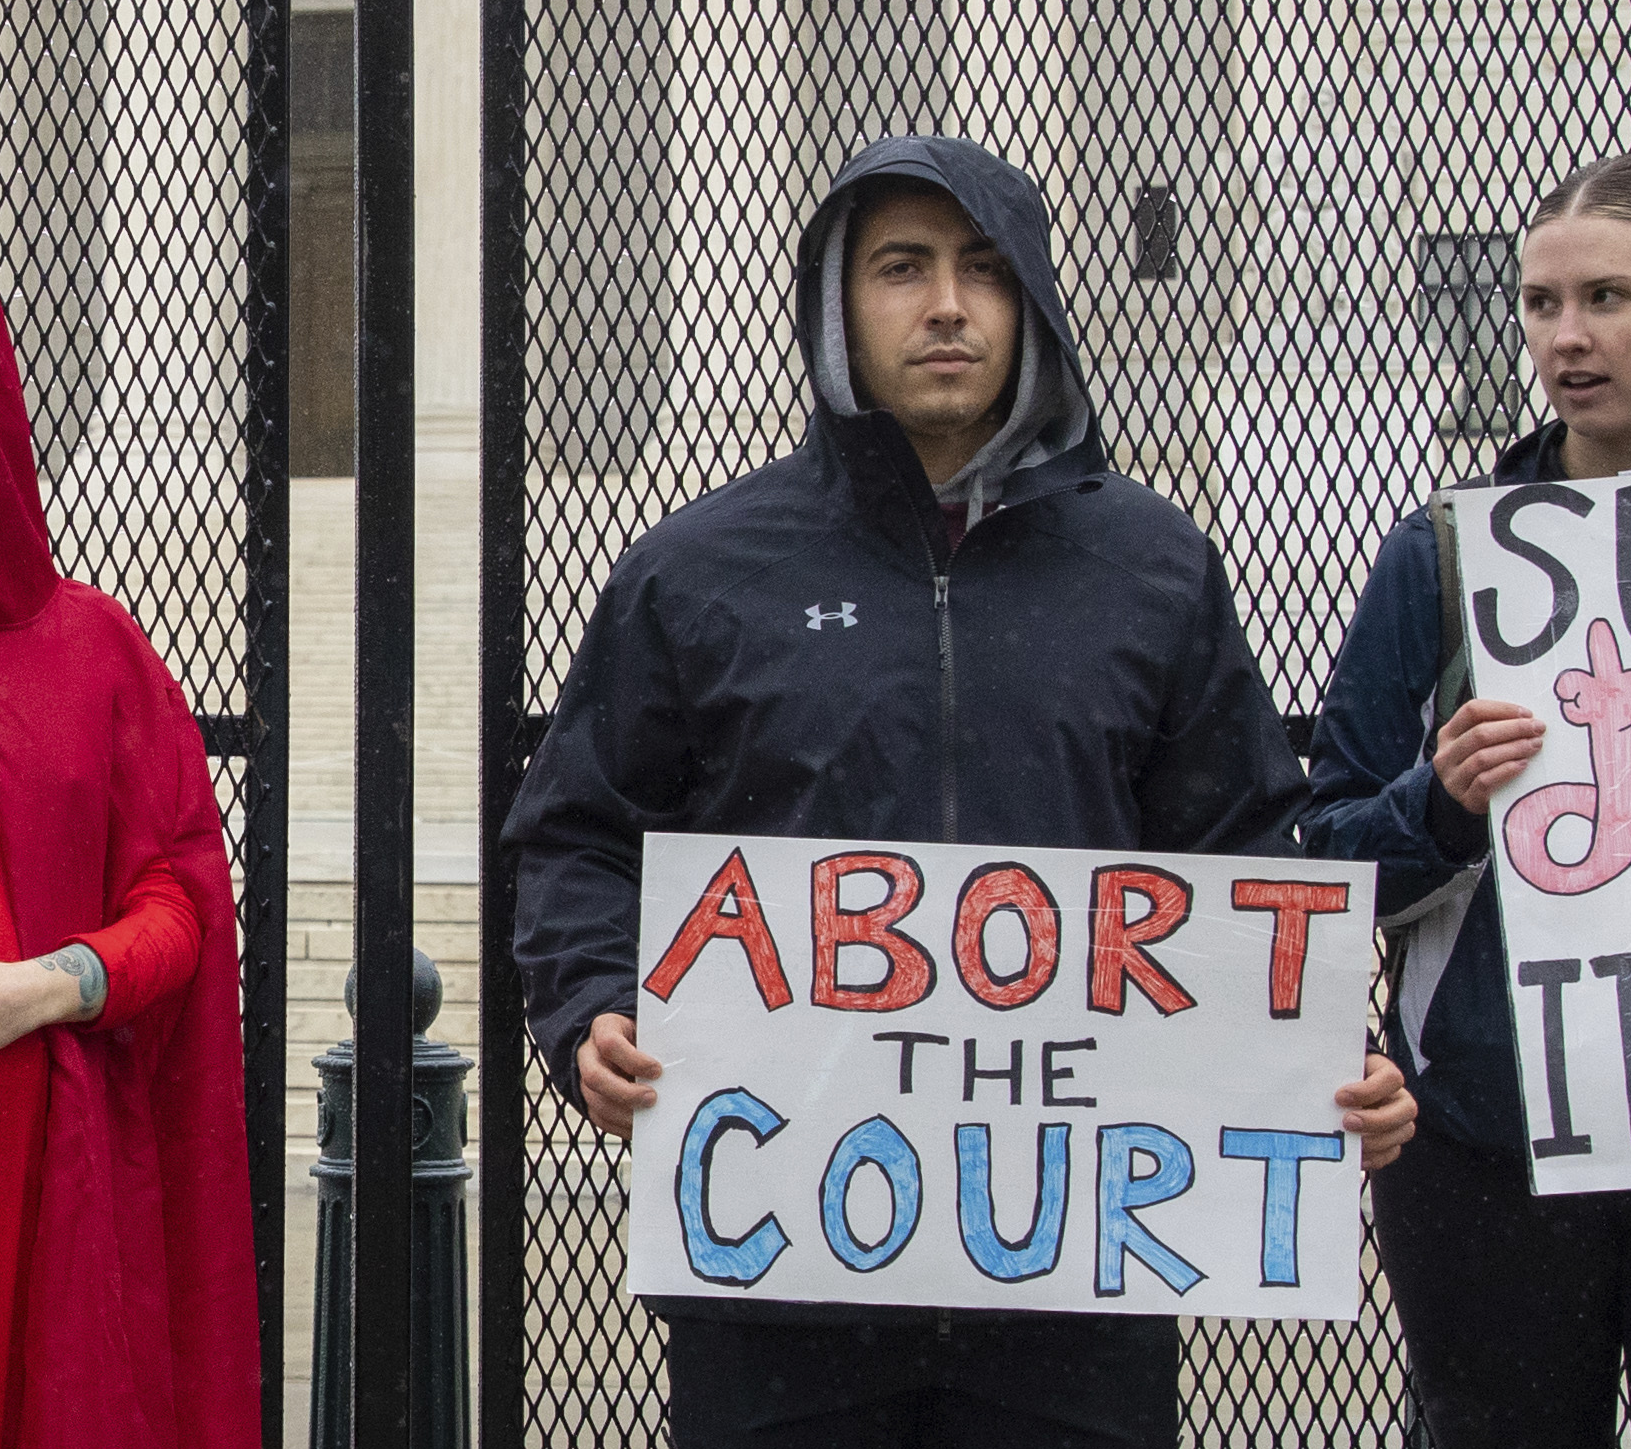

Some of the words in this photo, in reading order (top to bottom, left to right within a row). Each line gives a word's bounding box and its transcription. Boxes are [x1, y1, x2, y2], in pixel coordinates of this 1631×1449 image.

[642, 846, 1351, 1019] ABORT
[872, 1031, 1098, 1108] THE
[673, 1087, 1346, 1298] COURT
